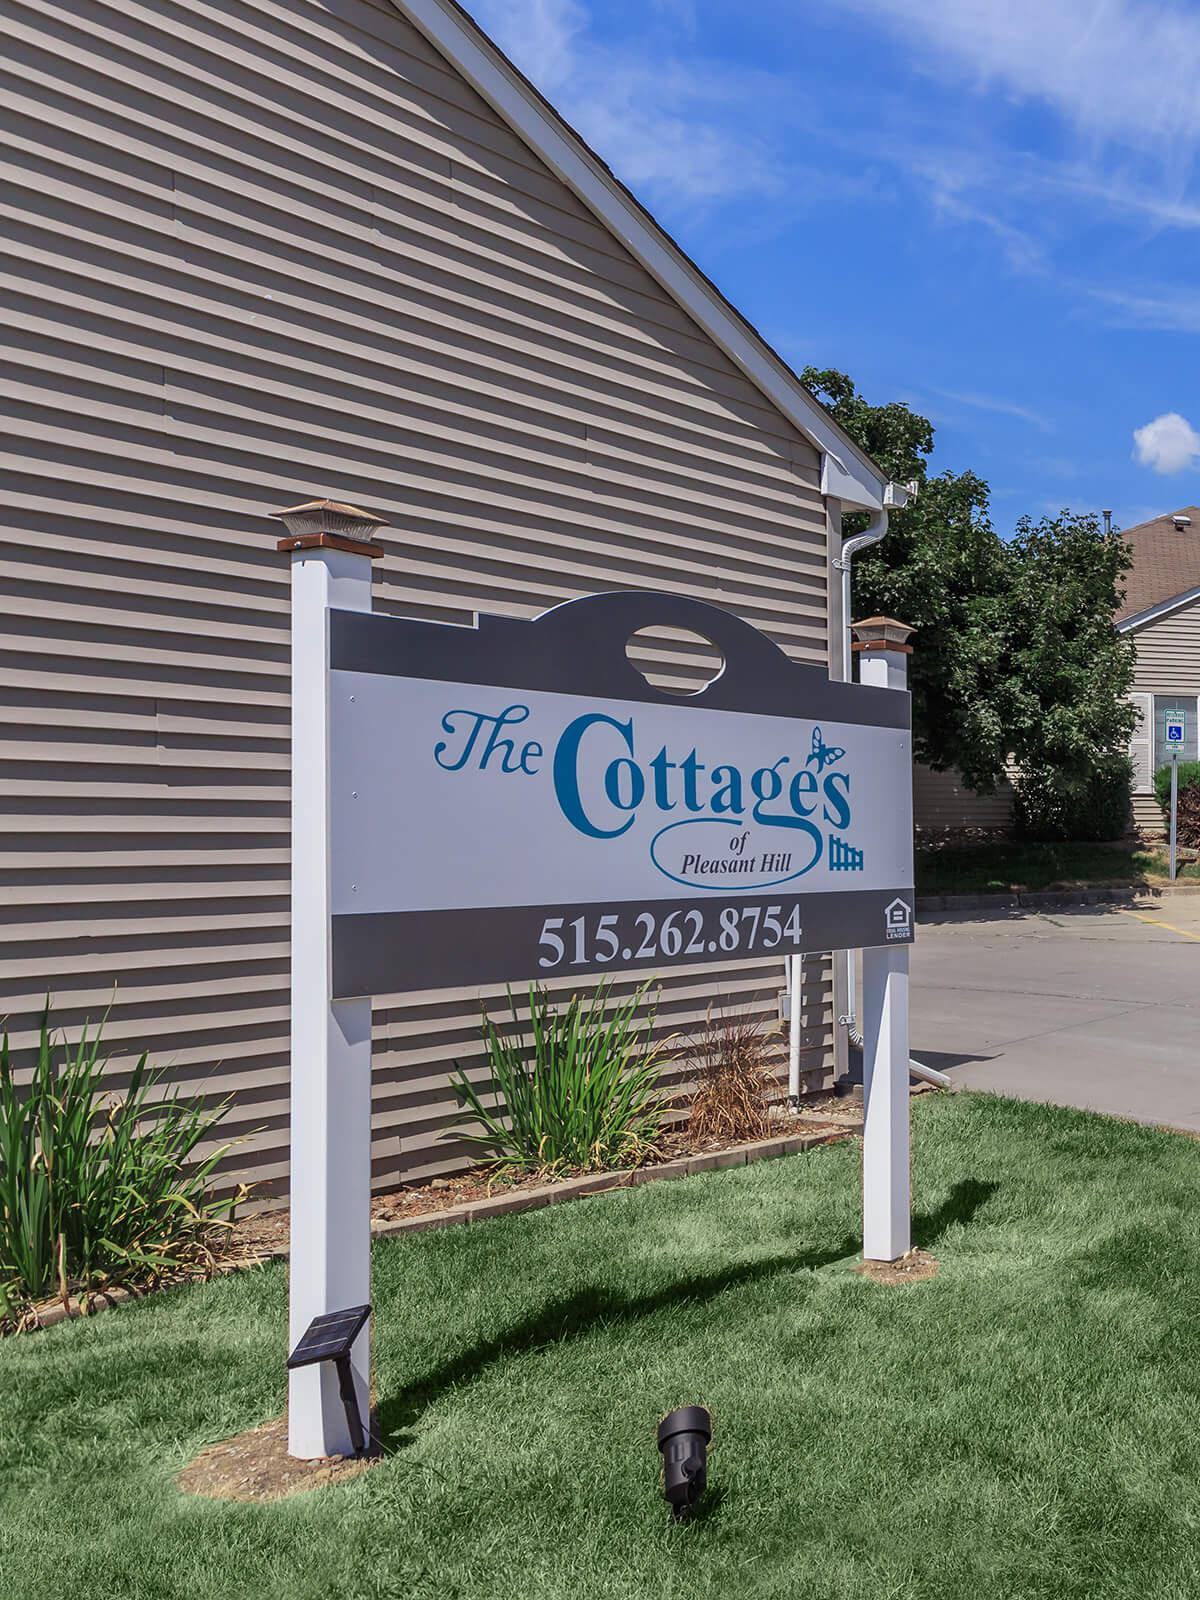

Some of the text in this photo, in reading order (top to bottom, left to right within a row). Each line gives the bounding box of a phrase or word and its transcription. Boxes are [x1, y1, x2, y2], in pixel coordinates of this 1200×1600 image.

[434, 704, 851, 830] The Cottages
[680, 852, 793, 876] Pleasant Hill
[729, 830, 748, 856] of
[537, 903, 803, 968] 515.262.8754
